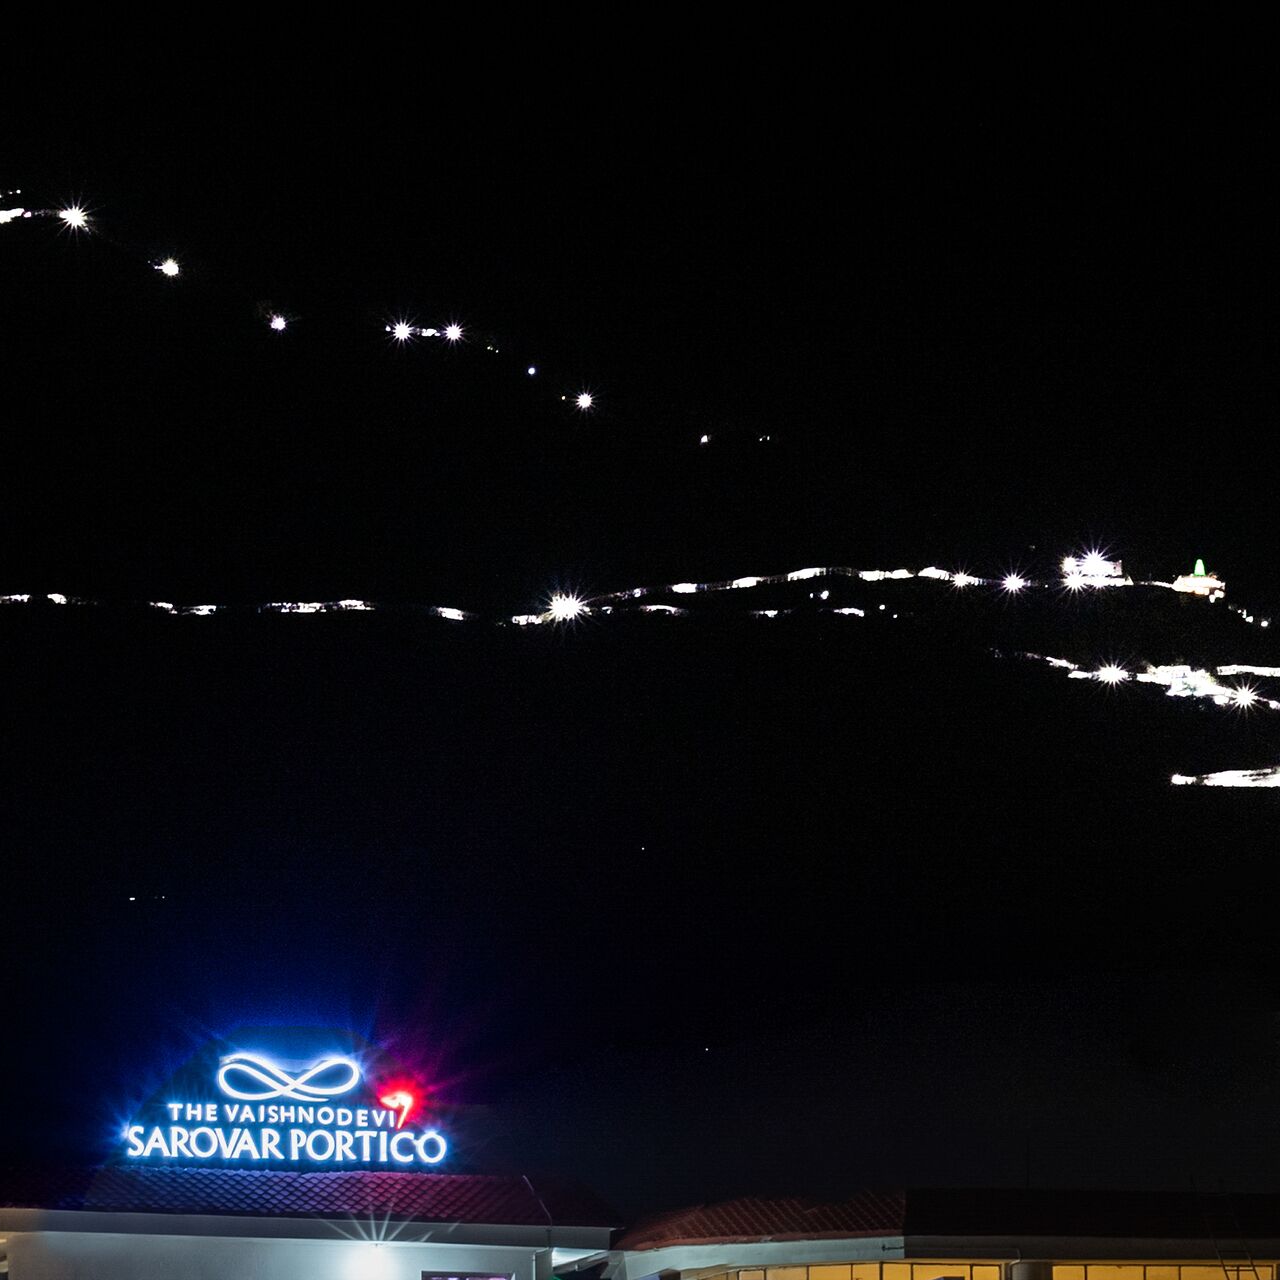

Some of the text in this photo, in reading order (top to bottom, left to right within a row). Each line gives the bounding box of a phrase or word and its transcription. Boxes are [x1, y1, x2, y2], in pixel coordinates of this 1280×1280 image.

[167, 1103, 395, 1128] THE VAISHNODEVI
[127, 1125, 447, 1163] SAROVAR PORTICO
